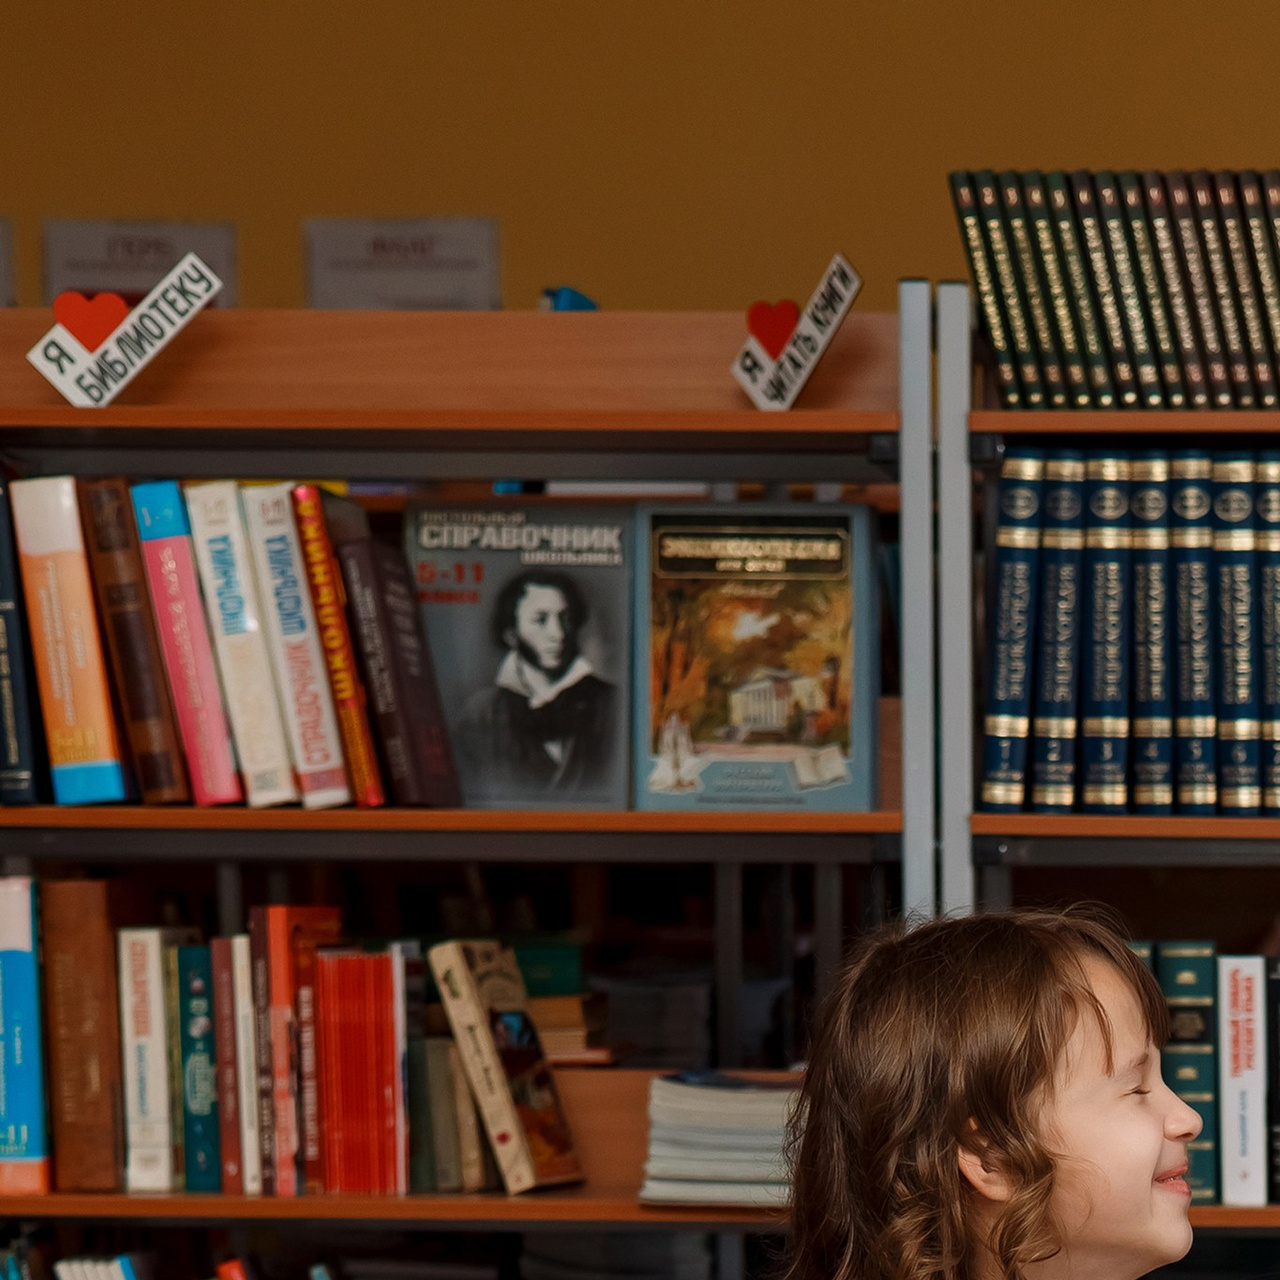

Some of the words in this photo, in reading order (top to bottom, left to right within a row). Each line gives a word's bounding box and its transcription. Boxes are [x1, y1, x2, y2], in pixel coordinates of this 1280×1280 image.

[43, 339, 75, 374] Я
[75, 260, 212, 405] БИБЛИОТЕКУ
[740, 350, 764, 385] Я
[420, 525, 623, 549] СПРАВОЧНИК
[299, 498, 355, 700] ШКОЛЬНИКА
[999, 739, 1011, 760] 1
[1047, 740, 1061, 761] 2
[1102, 741, 1113, 761] 3
